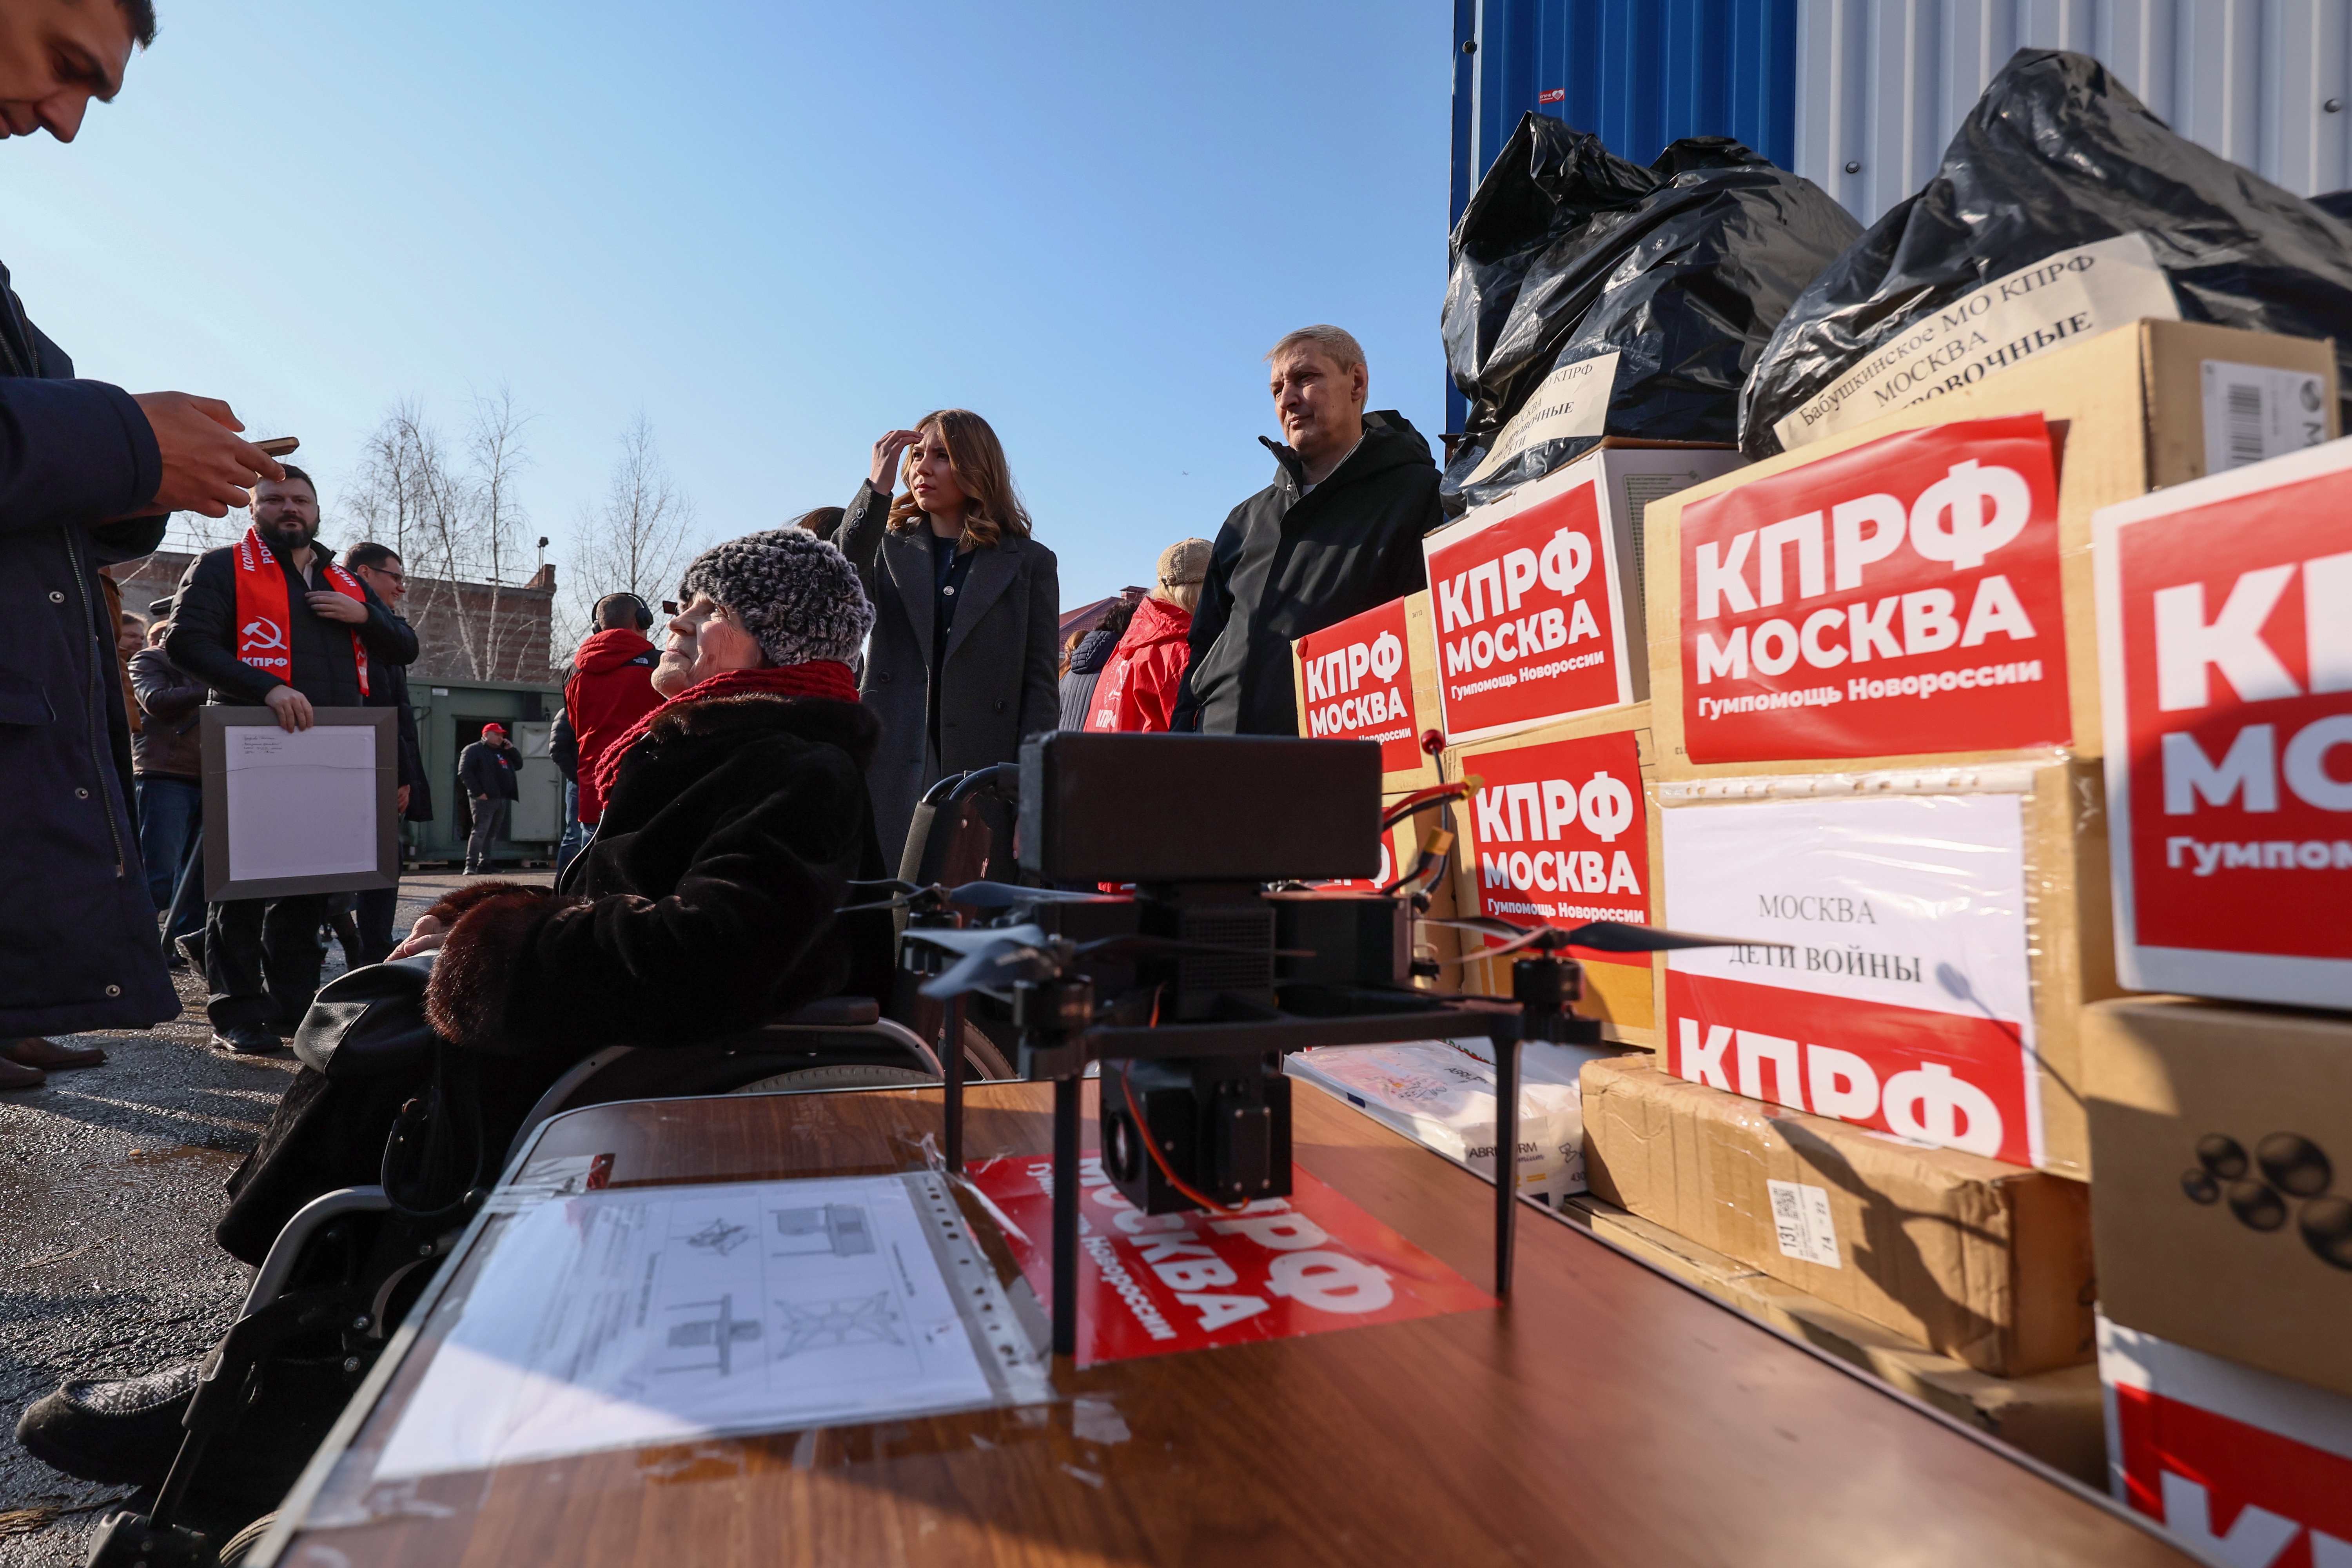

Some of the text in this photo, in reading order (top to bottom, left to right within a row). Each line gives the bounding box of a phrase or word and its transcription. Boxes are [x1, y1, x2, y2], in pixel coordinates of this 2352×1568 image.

[1798, 256, 2095, 427] Бабушкинское МО КПРФ
[1873, 330, 1989, 408] МОСКВА
[1553, 364, 1593, 385] КПРФ
[1696, 458, 2032, 621] КПРФ
[1438, 526, 1592, 633] КПРФ
[242, 657, 288, 667] КПРФ
[1445, 598, 1601, 677] МОСКВА
[1697, 575, 2037, 684] МОСКВА
[1305, 630, 1402, 702] КПРФ
[1451, 650, 1604, 701] Гумпомощь Новороссии
[1698, 660, 2042, 720] Гумпомощь Новороссии
[1310, 687, 1408, 738] МОСКВА
[1475, 771, 1633, 842] КПРФ
[1482, 851, 1641, 895] МОСКВА
[1488, 898, 1644, 923] Гумпомощь Новороссии
[1758, 894, 1877, 925] МОСКВА
[1729, 944, 1922, 984] ДЕТИ ВОЙНЫ
[1679, 1016, 2004, 1159] КПРФ
[1779, 1226, 1797, 1248] 131
[1080, 1236, 1177, 1341] Новороссии
